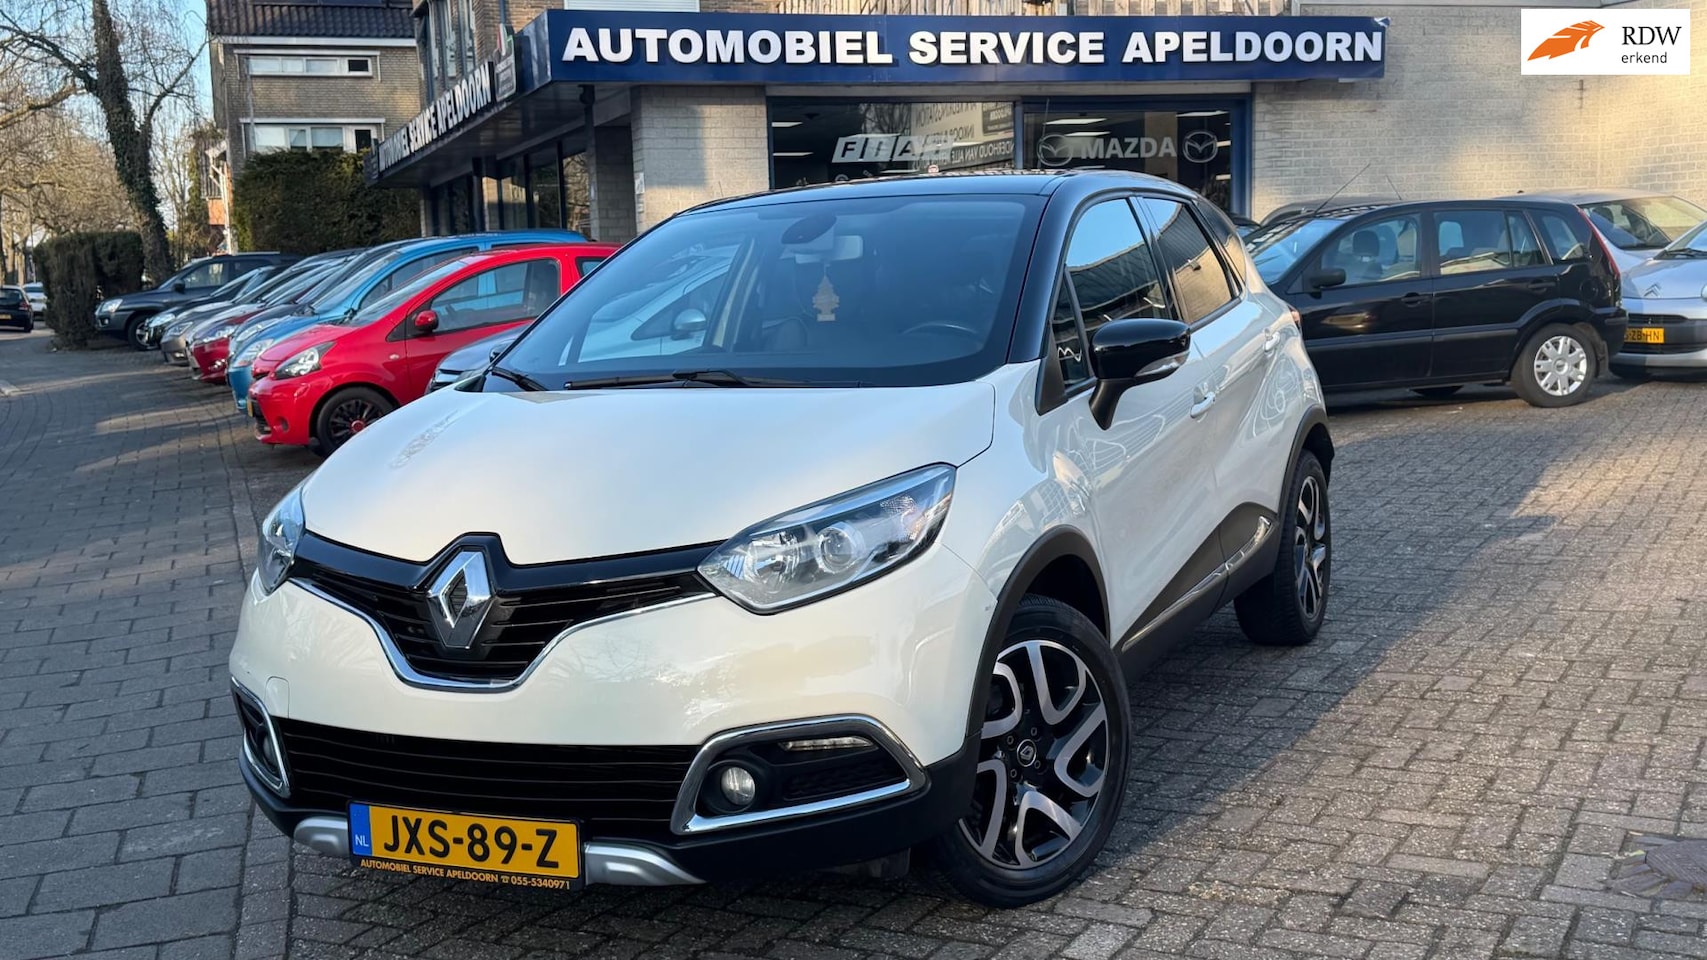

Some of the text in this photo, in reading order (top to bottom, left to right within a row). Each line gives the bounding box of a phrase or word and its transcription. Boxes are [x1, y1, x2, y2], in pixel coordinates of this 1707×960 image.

[561, 27, 1382, 64] AUTOMOBIEL SERVICE APELDOORN
[408, 102, 438, 153] SERVICE
[436, 60, 491, 136] APELDOORN
[1081, 137, 1177, 160] MAZDA
[355, 834, 370, 847] NL
[384, 815, 560, 869] JXS-89-Z
[360, 858, 570, 890] AUTOMOBIEL SERVICE APELDOORN 055-5340971
